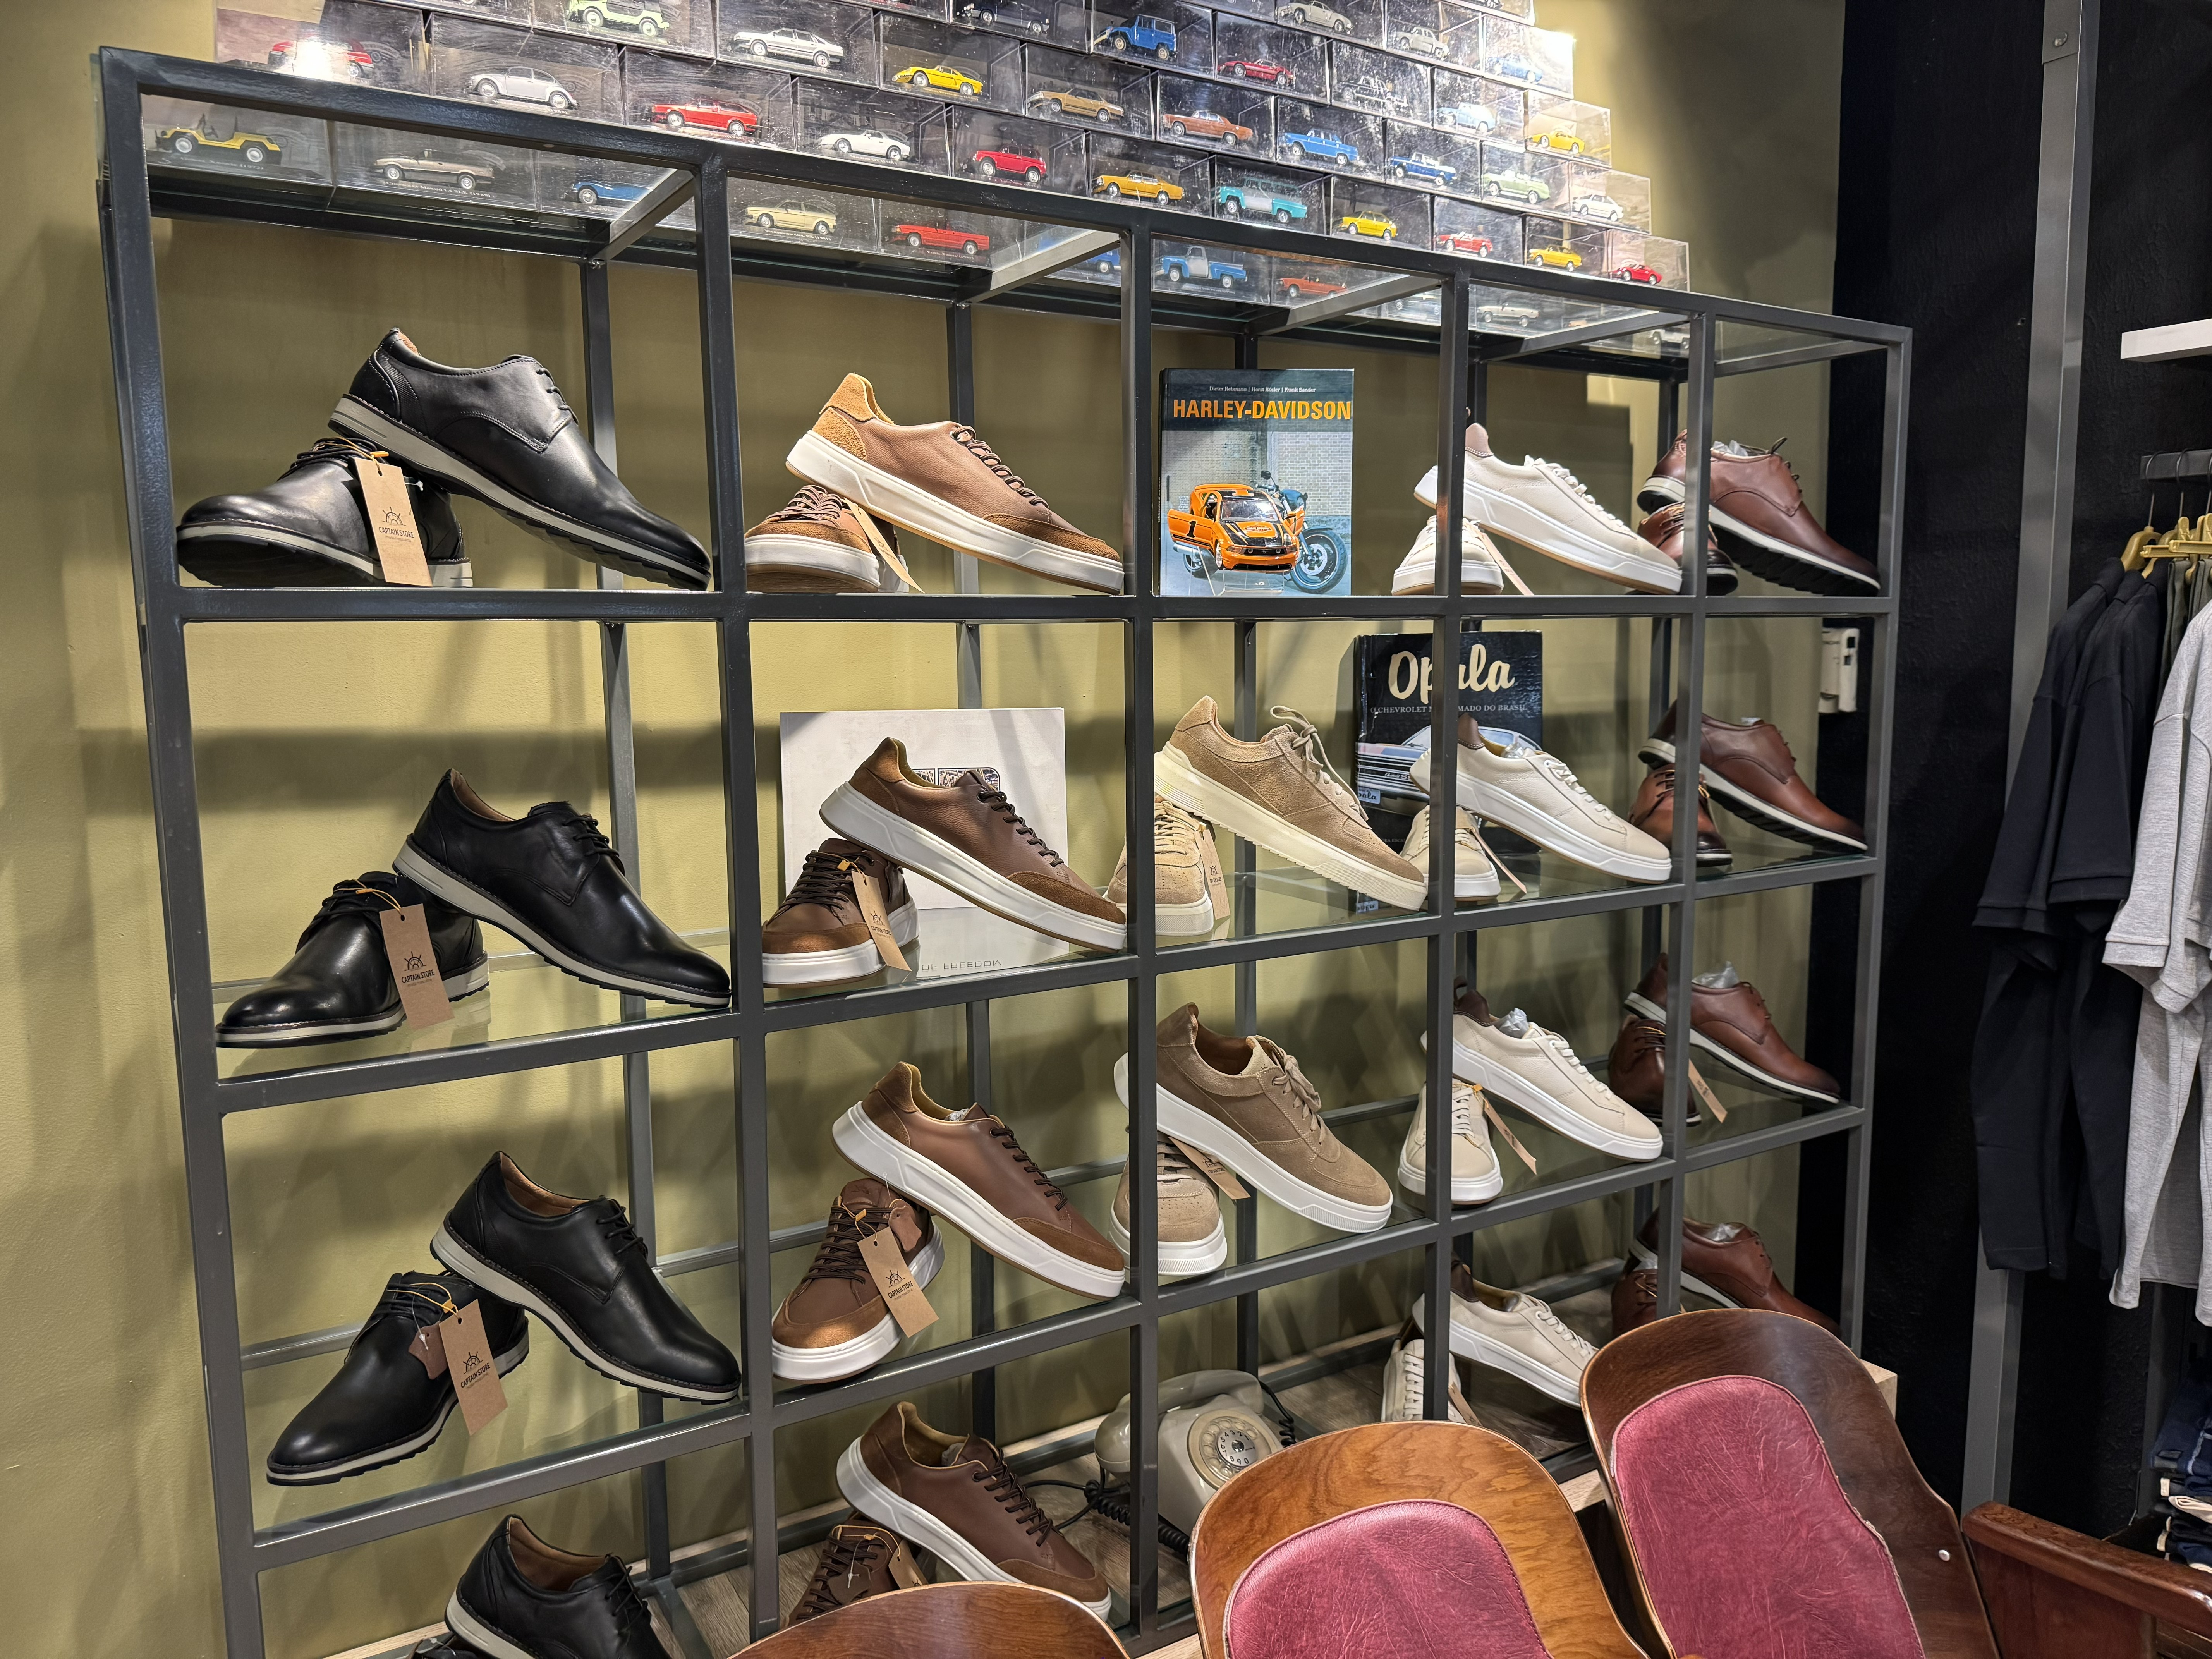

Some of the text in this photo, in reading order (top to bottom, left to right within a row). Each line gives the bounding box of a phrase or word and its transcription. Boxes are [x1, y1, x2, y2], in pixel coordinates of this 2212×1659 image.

[1173, 399, 1351, 419] HARLEY-DAVIDSON
[379, 527, 414, 538] CAPTAIN STORE
[1187, 521, 1196, 538] 1
[402, 973, 421, 983] CAPTAIN
[420, 969, 435, 979] STORE
[888, 1286, 903, 1298] CAPTAIN
[902, 1281, 913, 1290] STORE
[461, 1372, 477, 1388] CAPTAIN
[477, 1363, 490, 1375] STORE
